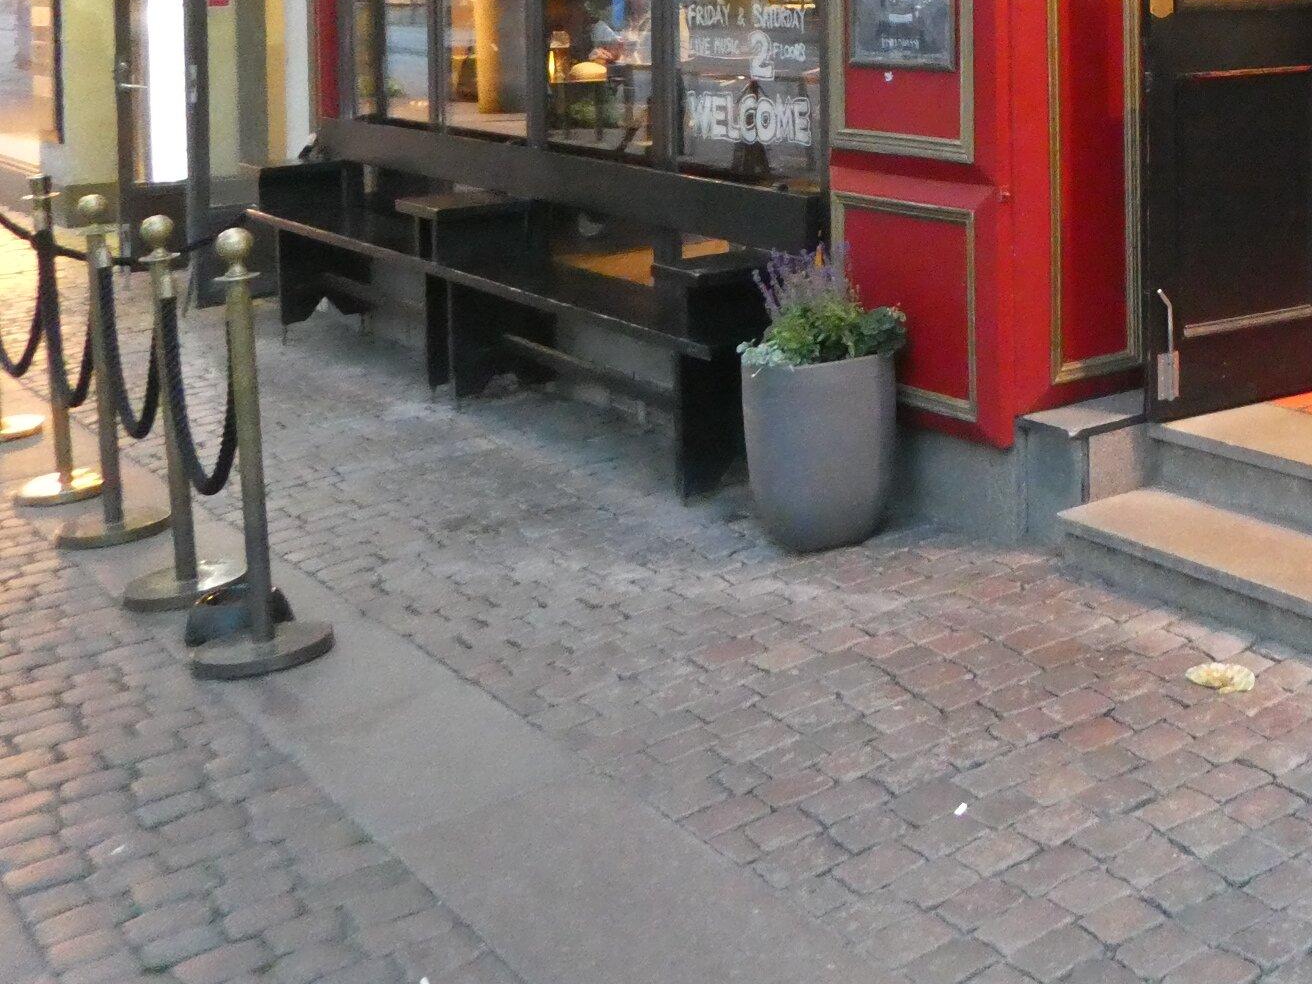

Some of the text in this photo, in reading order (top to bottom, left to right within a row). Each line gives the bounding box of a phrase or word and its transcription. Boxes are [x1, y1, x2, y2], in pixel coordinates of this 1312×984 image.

[687, 3, 730, 27] FRIDAY
[748, 29, 775, 81] 2
[686, 90, 812, 147] WELCOME
